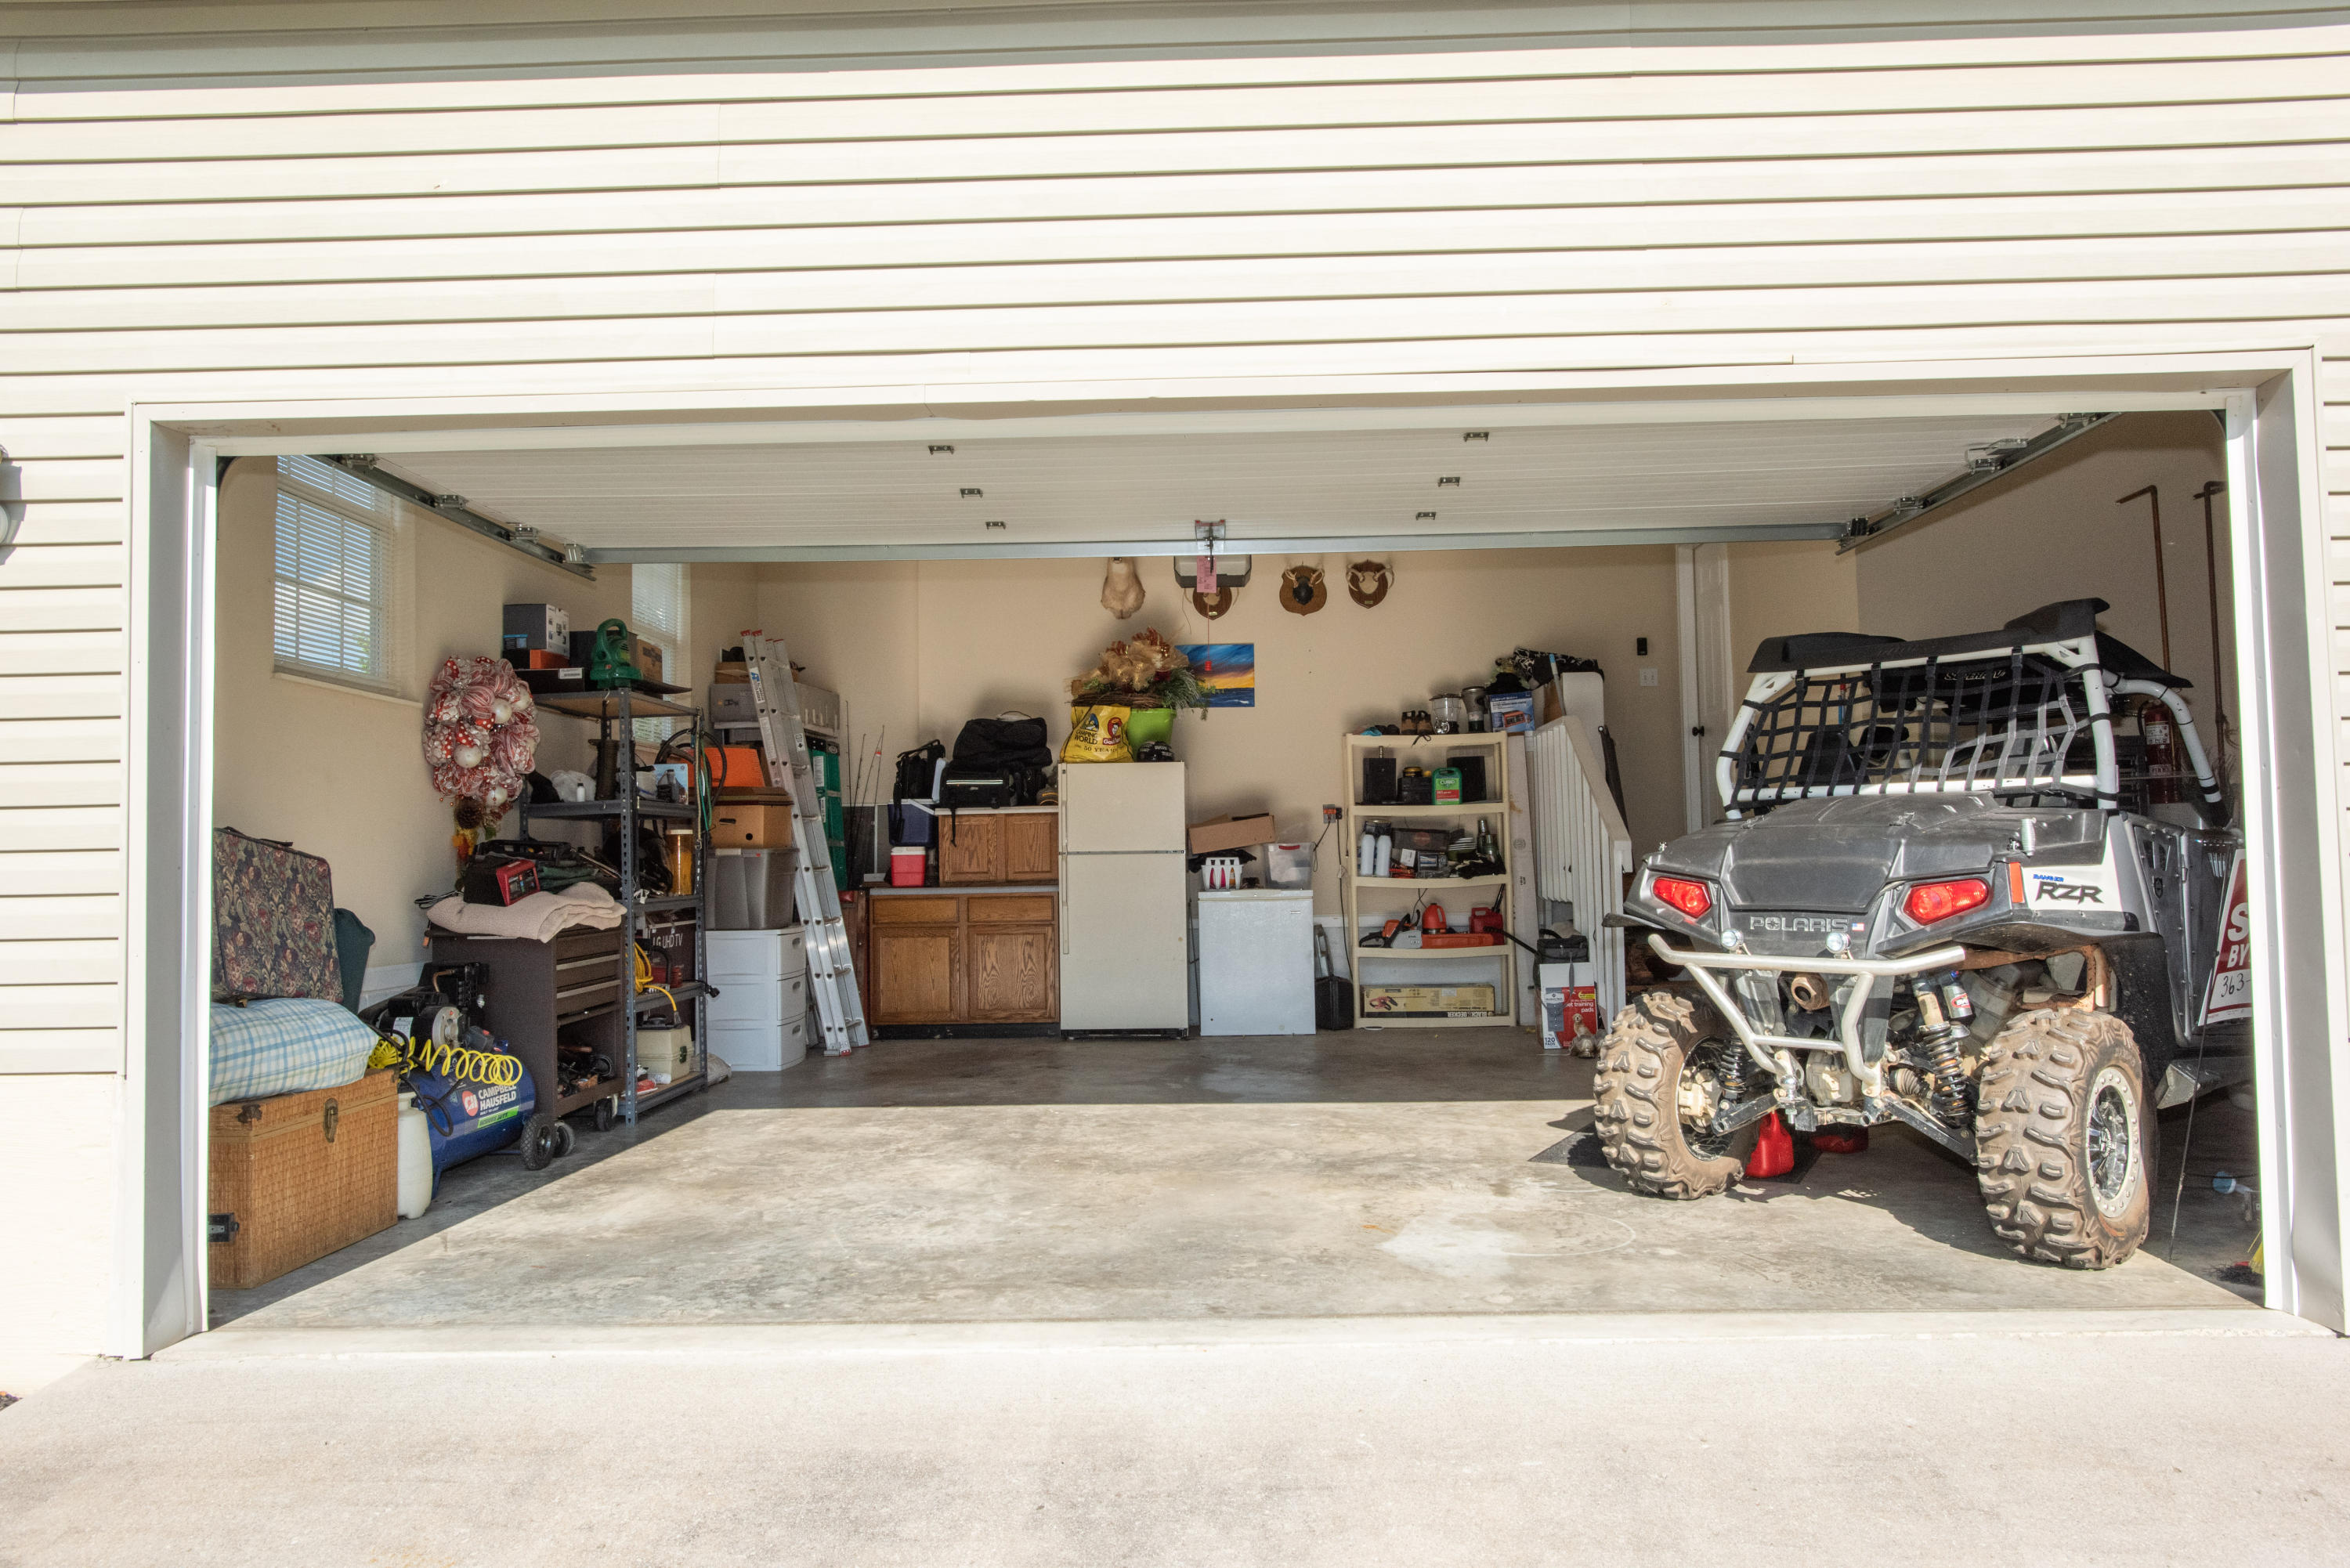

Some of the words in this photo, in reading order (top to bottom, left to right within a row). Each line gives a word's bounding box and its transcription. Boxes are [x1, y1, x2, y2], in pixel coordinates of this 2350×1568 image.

[1075, 735, 1097, 745] WORLD
[1076, 728, 1097, 739] CAMPING
[2033, 873, 2064, 882] RANGER
[2035, 880, 2104, 905] RZR
[1750, 916, 1849, 933] POLARIS
[663, 934, 674, 948] UHD
[675, 934, 683, 947] TV
[2227, 943, 2250, 968] BY
[479, 1084, 516, 1099] CAMPBELL
[479, 1091, 516, 1111] HAUSFELD
